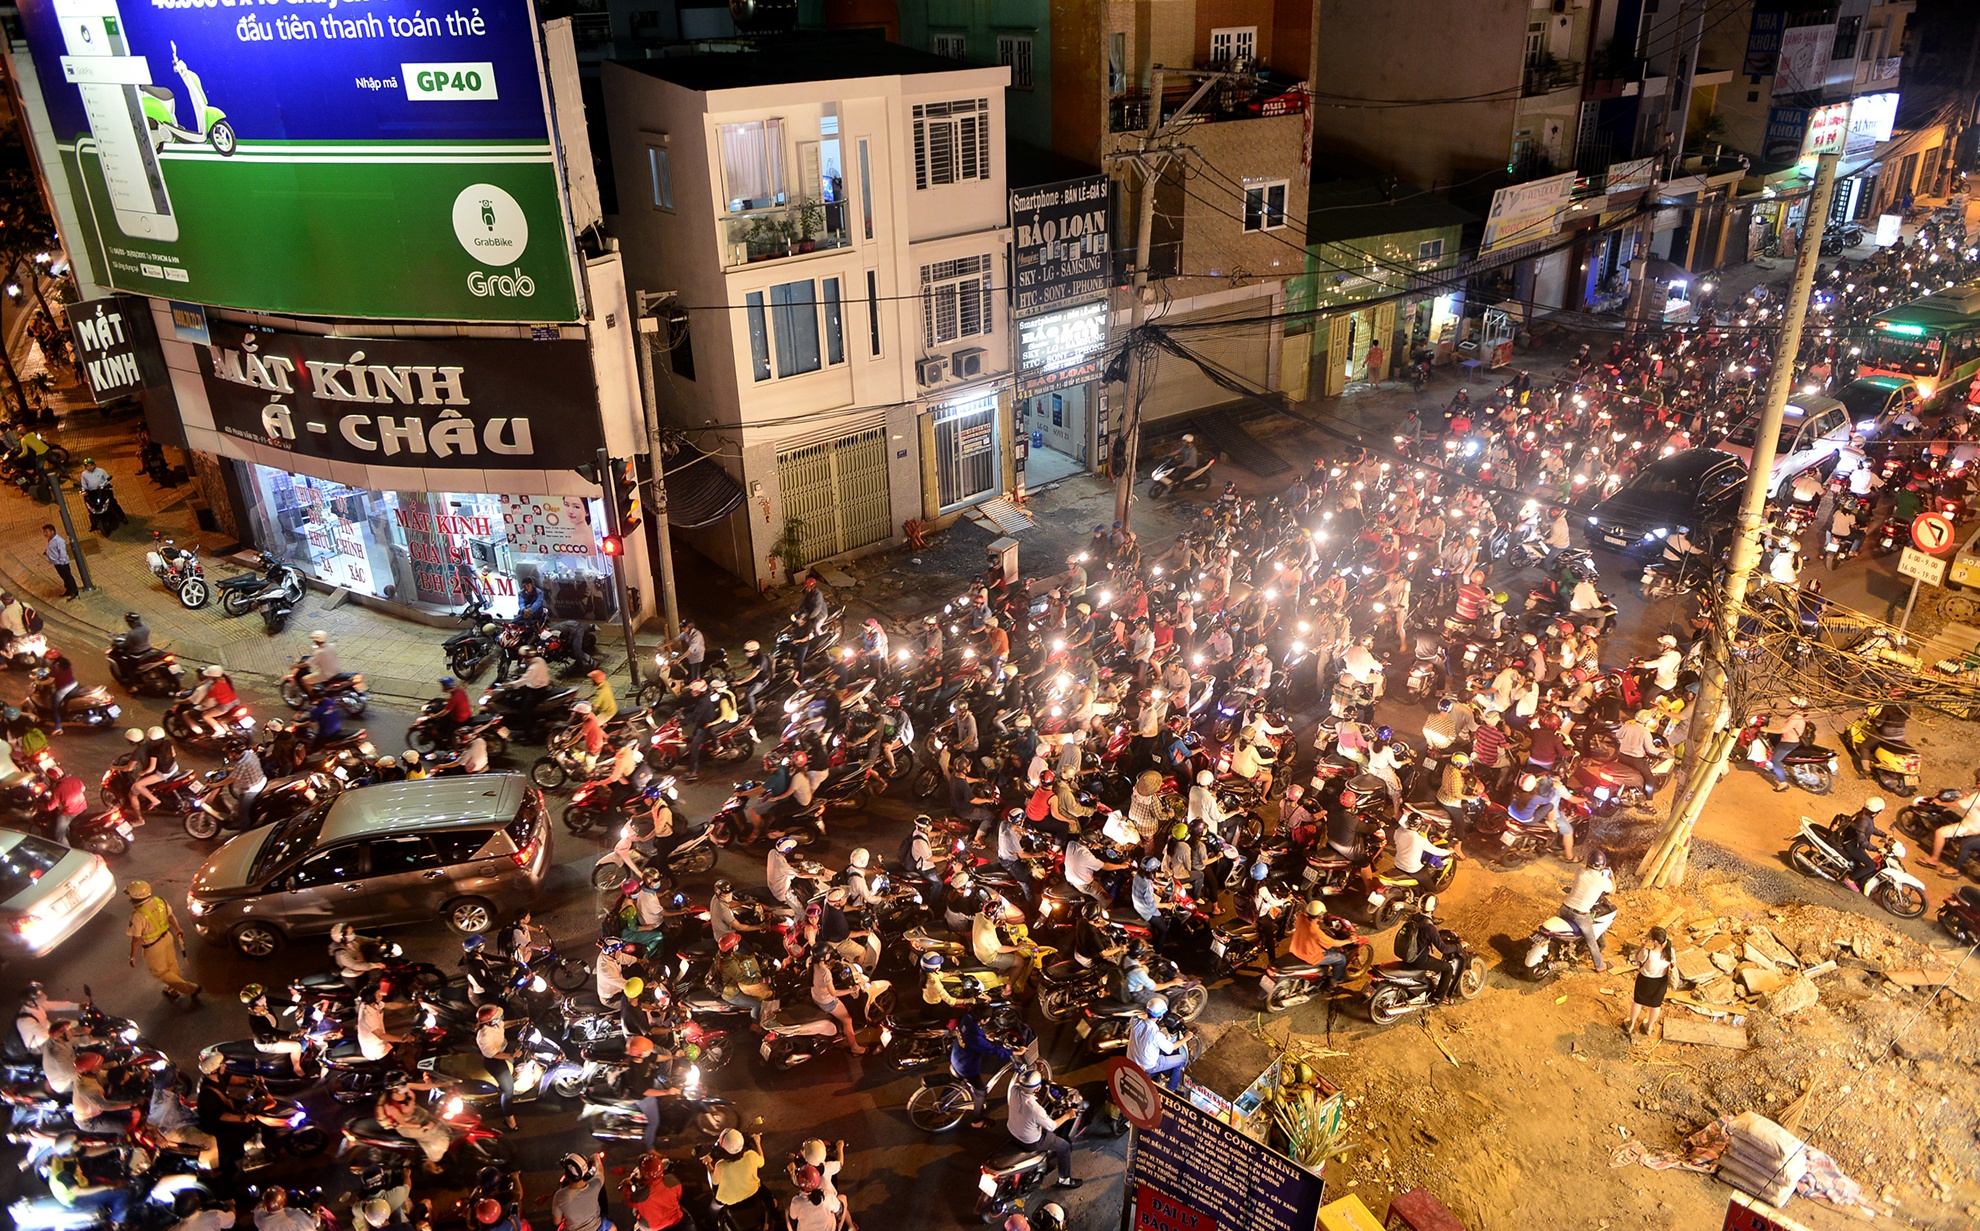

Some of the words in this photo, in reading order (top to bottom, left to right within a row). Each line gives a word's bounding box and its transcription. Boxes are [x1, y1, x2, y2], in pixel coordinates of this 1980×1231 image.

[236, 13, 273, 42] đầu
[276, 14, 318, 40] tiên
[320, 12, 384, 39] thanh
[387, 10, 441, 38] toán
[446, 8, 486, 36] thẻ
[1756, 13, 1777, 30] NHA
[1750, 34, 1777, 50] KHOA
[355, 77, 381, 91] Nhập
[383, 76, 398, 88] mã
[416, 71, 482, 92] GP40
[1776, 110, 1800, 123] NHA
[1769, 123, 1800, 138] KHOA
[1013, 186, 1059, 217] Smartphone
[1064, 184, 1077, 203] BÁN
[1100, 177, 1107, 197] SỈ
[1017, 211, 1056, 248] BẢO
[1059, 210, 1105, 239] LOAN
[474, 238, 513, 247] GrabBike
[1019, 269, 1036, 286] SKY
[1042, 265, 1054, 281] LG
[1060, 255, 1100, 277] SAMSUNG
[467, 267, 536, 297] Grab
[1019, 290, 1037, 308] HTC
[1043, 283, 1066, 301] SONY
[1072, 275, 1103, 294] IPHONE
[1019, 312, 1061, 330] Smartphone
[1025, 306, 1040, 314] 411
[77, 304, 126, 352] MẮT
[1021, 321, 1059, 344] BẢO
[1061, 314, 1106, 334] LOAN
[1022, 348, 1038, 360] SKY
[1048, 343, 1058, 353] LG
[1022, 357, 1039, 369] HTC
[1047, 350, 1068, 363] SONY
[1074, 341, 1105, 356] IPHONE
[87, 351, 141, 393] KÍNH
[208, 332, 295, 395] MẮT
[304, 350, 471, 405] KÍNH
[1059, 363, 1095, 379] LOAN
[1017, 388, 1032, 400] 411
[262, 394, 296, 440] Á
[338, 408, 535, 459] CHÂU
[335, 496, 349, 514] UY
[338, 515, 354, 536] TÍN
[393, 501, 431, 533] MẮT
[434, 509, 492, 536] KÍNH
[336, 537, 365, 560] CHÍNH
[409, 540, 441, 565] GIÁ
[449, 538, 474, 566] SỈ
[321, 555, 333, 574] XẠ
[348, 562, 366, 584] XÁC
[419, 571, 445, 595] BH
[462, 573, 516, 597] NĂM
[1197, 1085, 1212, 1101] SIÊU
[1212, 1094, 1230, 1111] SẠCH
[1157, 1091, 1199, 1122] THÔNG
[1199, 1117, 1221, 1135] TIN
[1222, 1128, 1258, 1156] CÔNG
[1259, 1149, 1302, 1181] TRÌNH
[1173, 1151, 1184, 1162] KHU
[1207, 1171, 1221, 1182] GIAO
[1181, 1171, 1197, 1184] CÔNG
[1196, 1180, 1204, 1188] TY
[1227, 1197, 1239, 1208] XÂY
[1192, 1185, 1210, 1199] QUANG
[1210, 1195, 1223, 1206] NAM
[1152, 1197, 1178, 1218] ĐẠI
[1270, 1193, 1282, 1204] CÂY
[1282, 1200, 1298, 1213] XANH
[1141, 1211, 1169, 1231] BẢO
